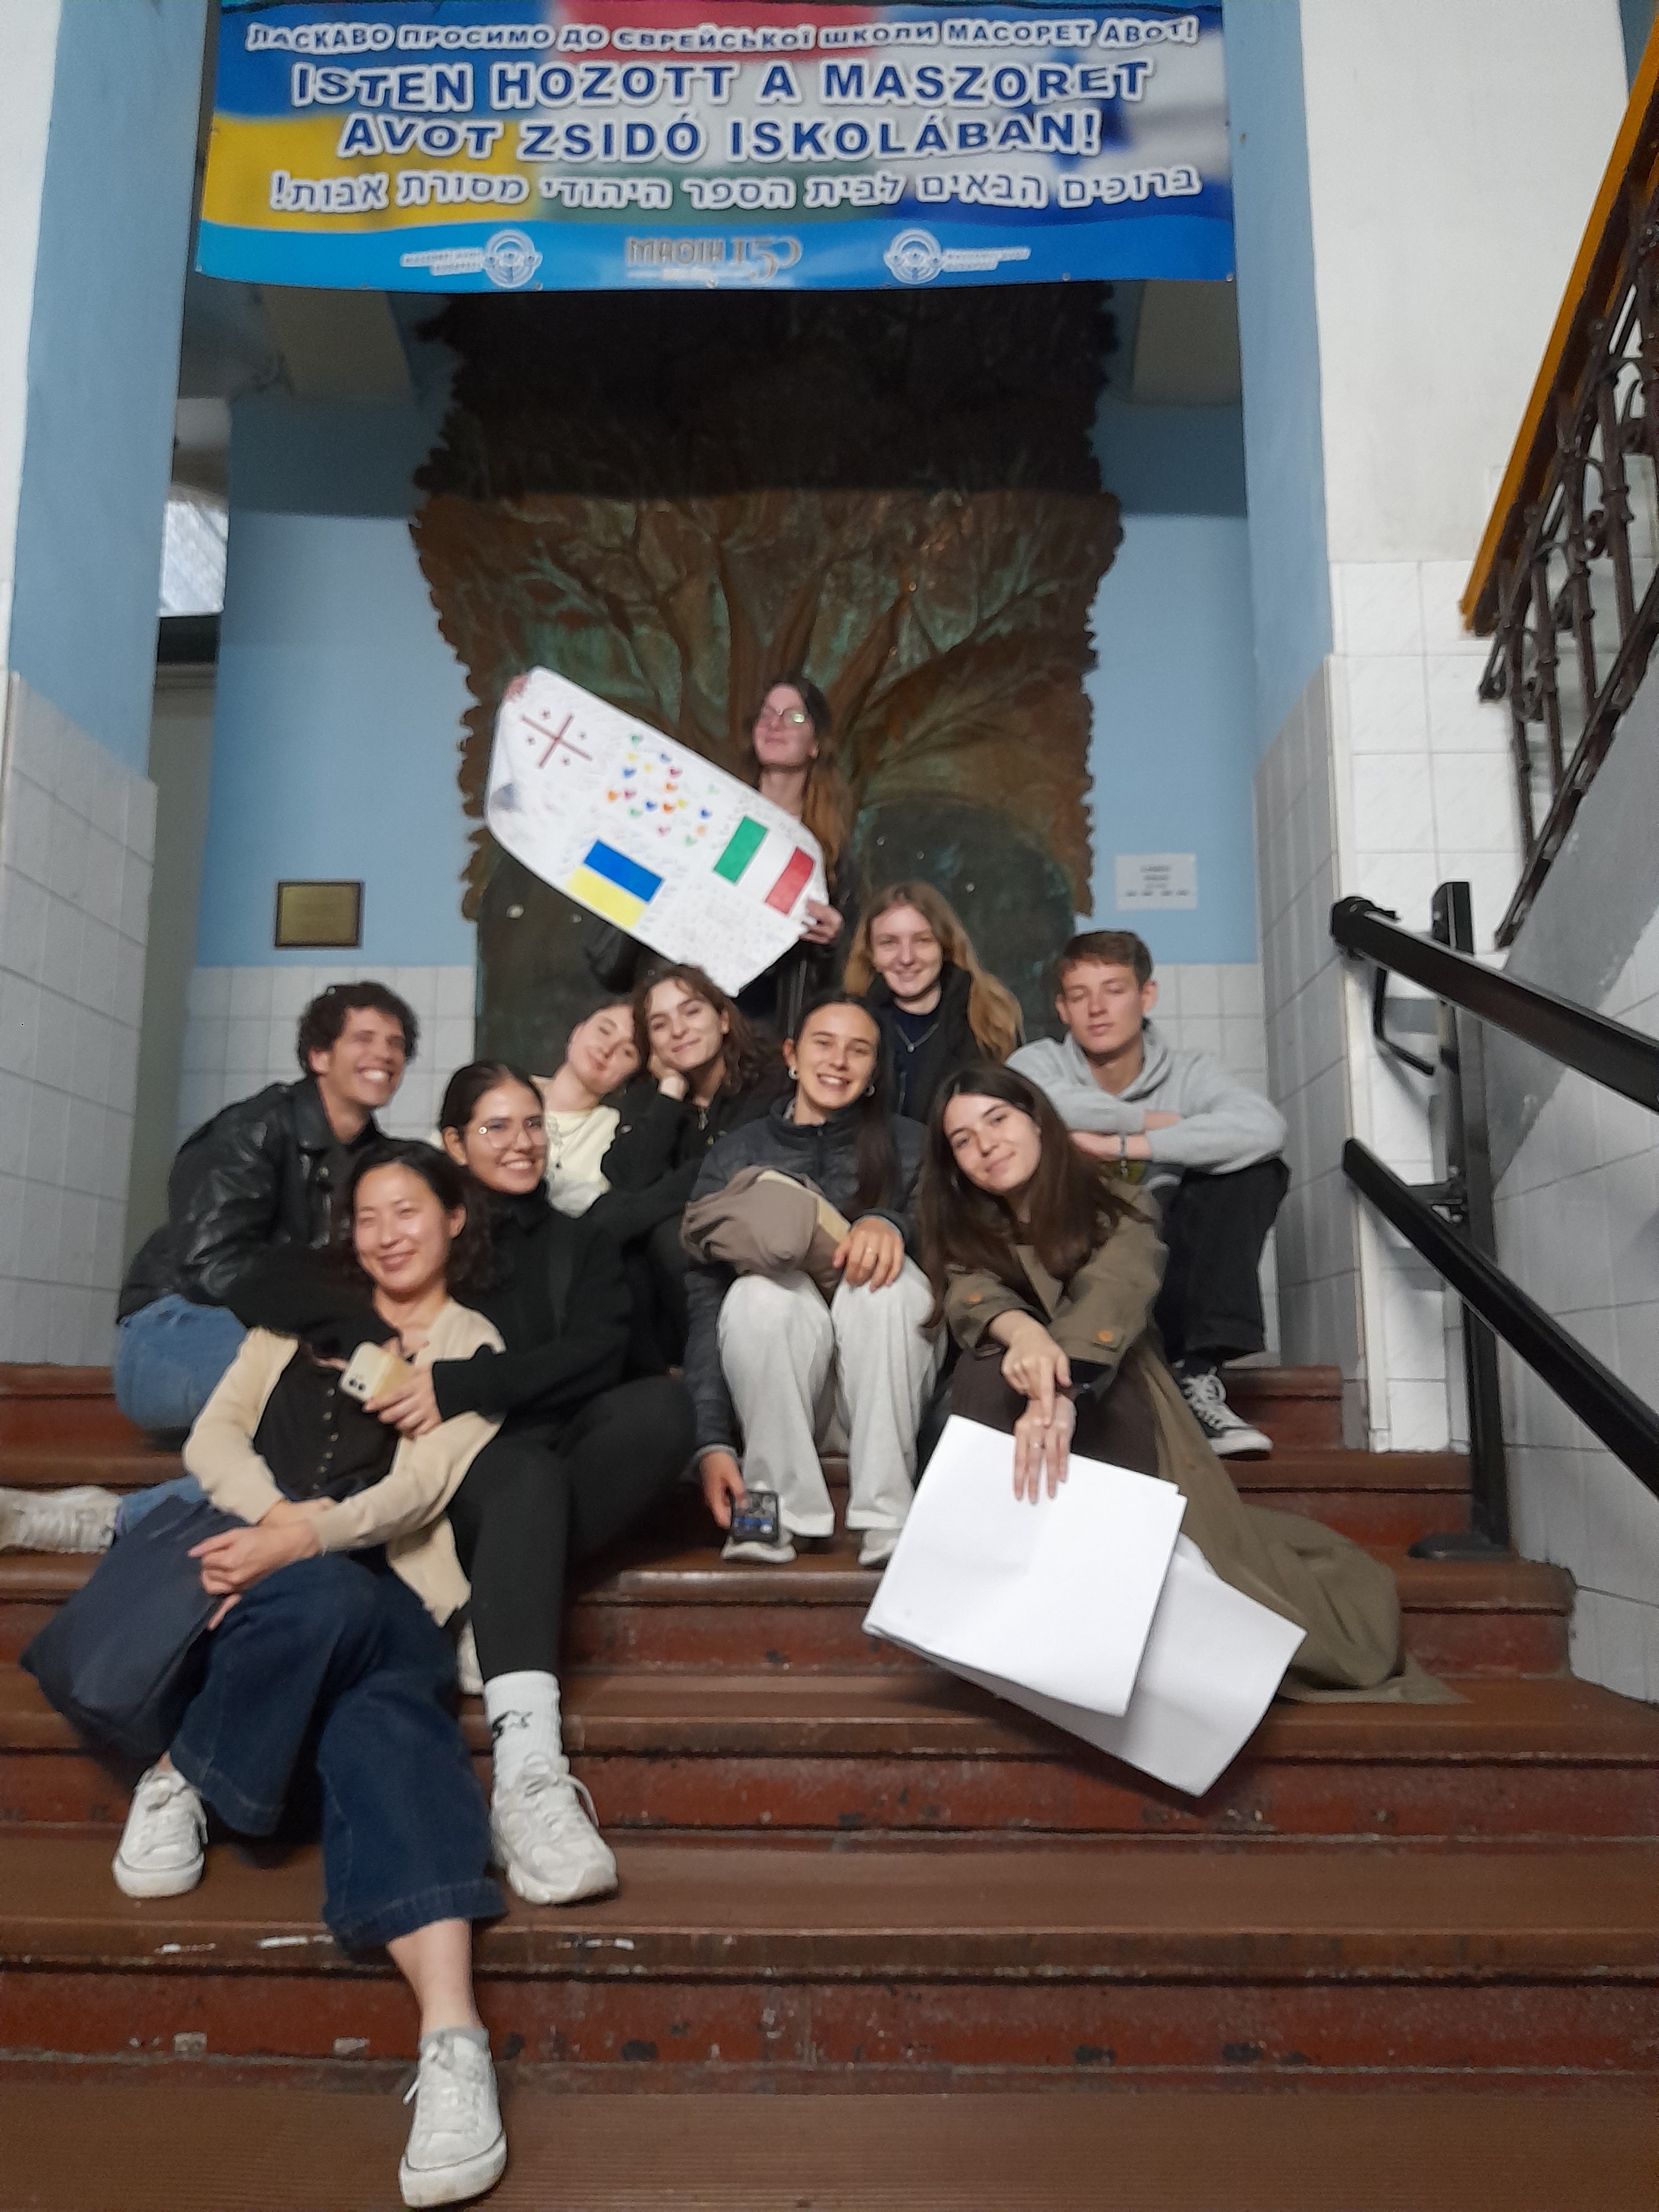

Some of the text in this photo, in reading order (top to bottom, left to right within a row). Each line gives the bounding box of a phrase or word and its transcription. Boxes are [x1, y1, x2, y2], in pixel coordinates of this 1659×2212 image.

[403, 28, 550, 45] ПРОСИМО
[562, 28, 604, 47] ДО
[823, 25, 934, 44] ШКОЛИ
[946, 23, 1093, 42] МАСОРЕТ
[296, 60, 1149, 106] ISTEN HOZOTT A MASZORET
[342, 112, 1095, 158] AVOT ZSIDÓ ISKOLÁBAN!
[275, 168, 1194, 207] ברוכים הבאים לבית הספר היהודי מסורת אבות!
